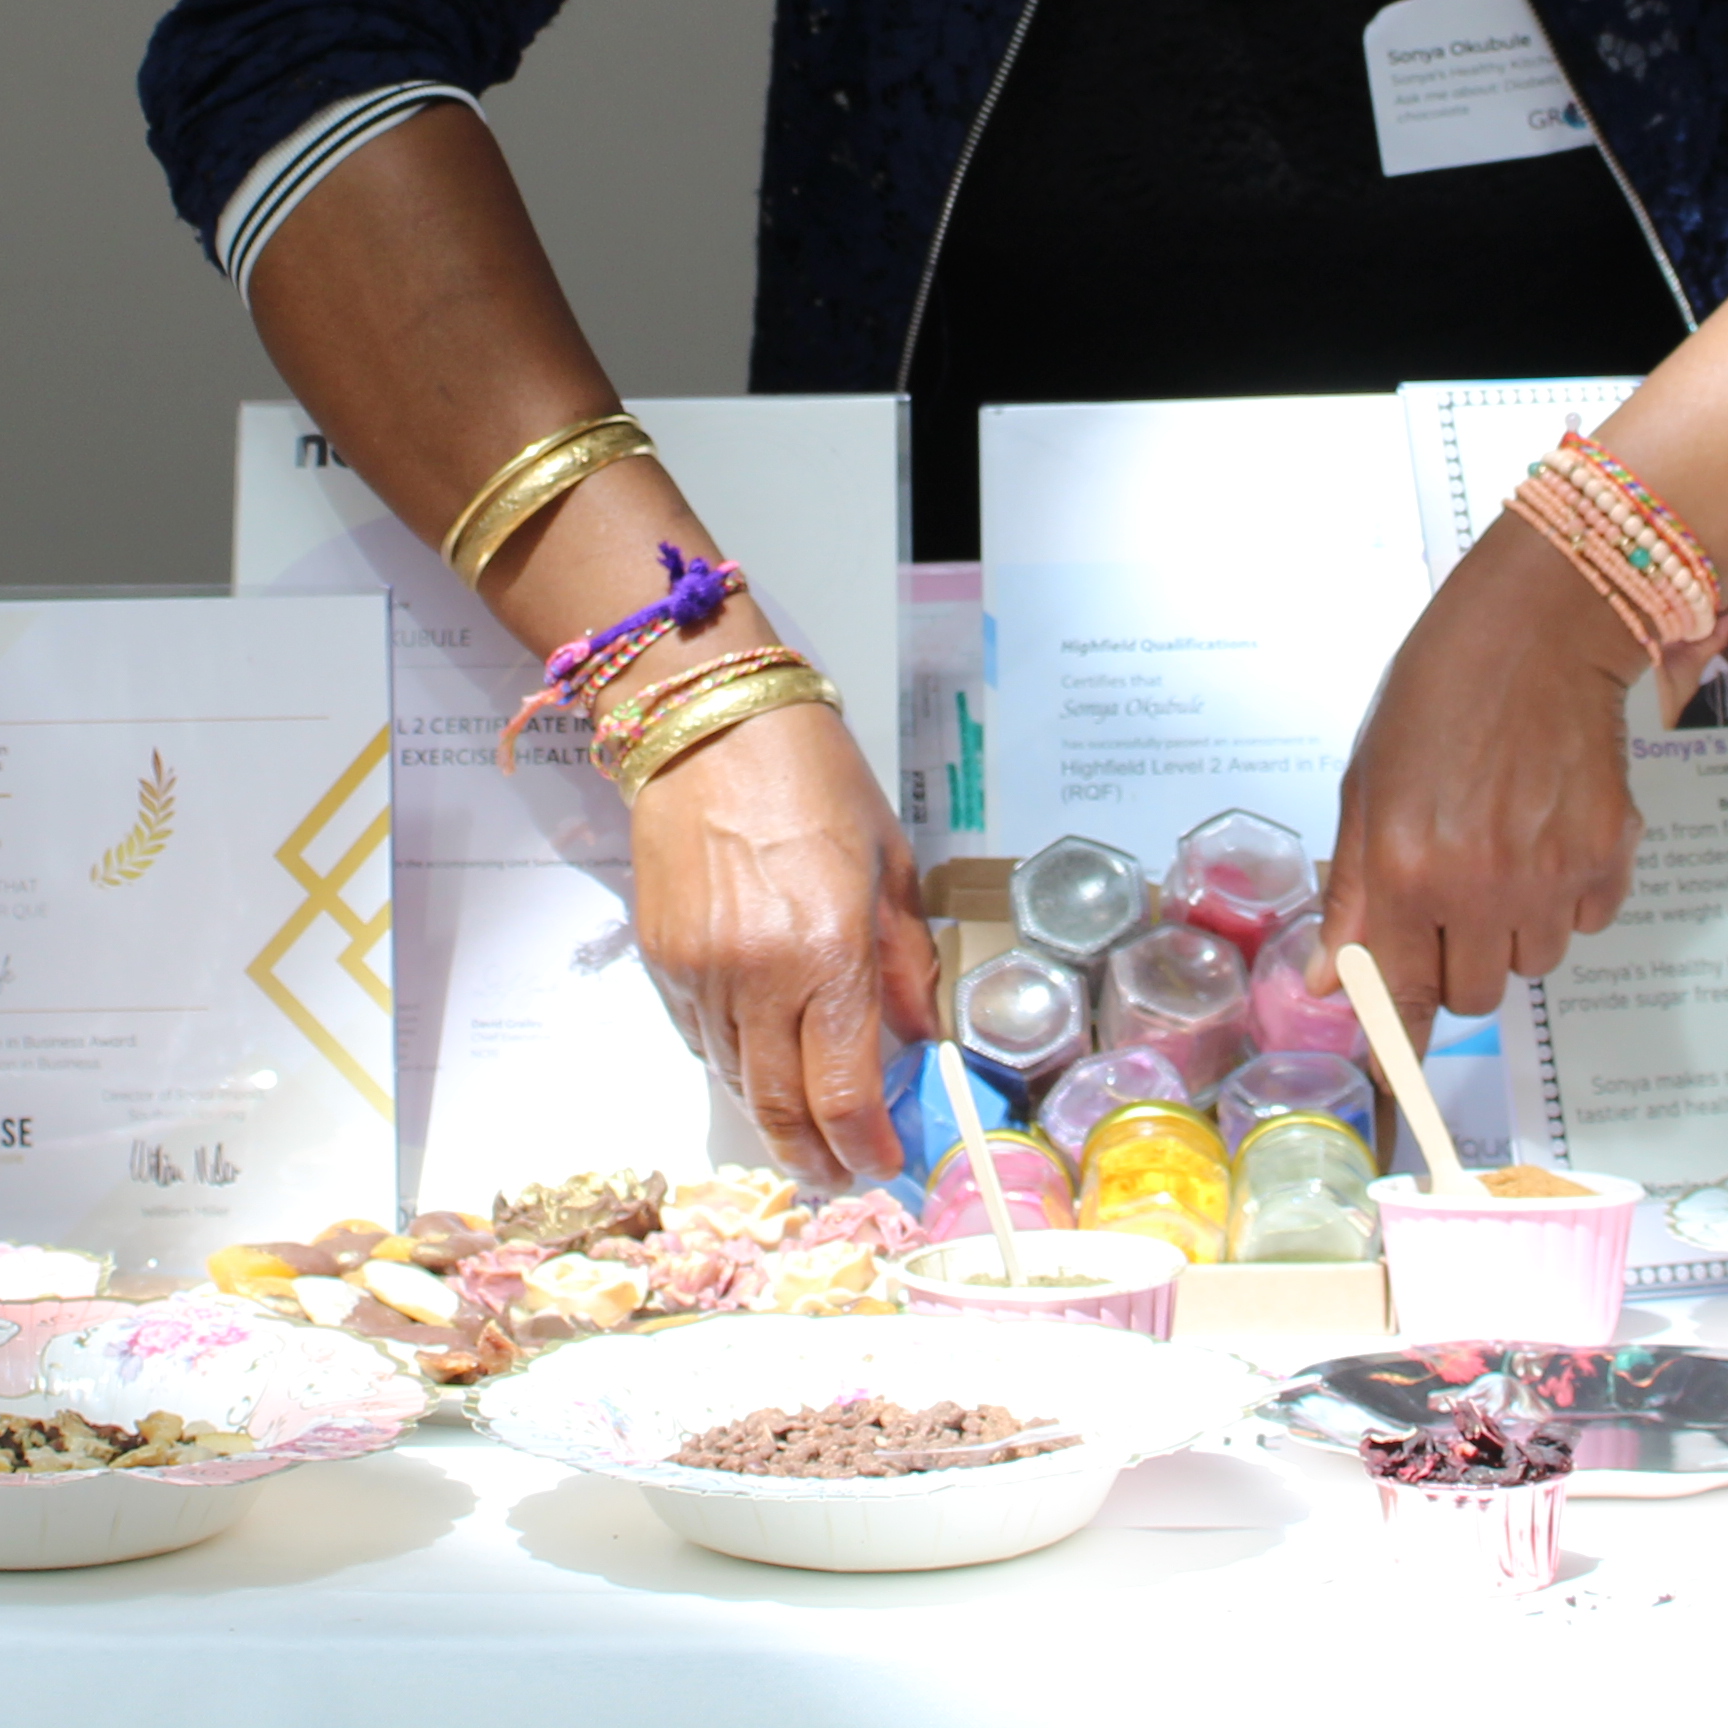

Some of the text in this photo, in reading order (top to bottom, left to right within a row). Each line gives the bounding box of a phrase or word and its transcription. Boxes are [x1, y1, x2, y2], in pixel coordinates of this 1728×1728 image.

[1387, 47, 1445, 66] Sonya
[1060, 636, 1259, 657] Highfield Qualifications
[1060, 673, 1163, 689] Certifies that
[1059, 698, 1119, 725] Sonya
[412, 717, 425, 735] 2
[1631, 735, 1728, 762] Sonya's
[1060, 756, 1313, 780] Highfield Level 2 Award in
[1061, 783, 1123, 804] (RQF)
[1671, 819, 1717, 841] from
[1639, 876, 1671, 898] her
[1660, 901, 1725, 928] weight
[1572, 960, 1648, 988] Sonya's
[1650, 958, 1724, 986] Healthy
[1557, 991, 1631, 1017] provide
[1633, 988, 1690, 1014] sugar
[1590, 1072, 1651, 1098] Sonya
[1655, 1068, 1721, 1092] makes
[1575, 1102, 1639, 1127] tastier
[1644, 1099, 1680, 1122] and
